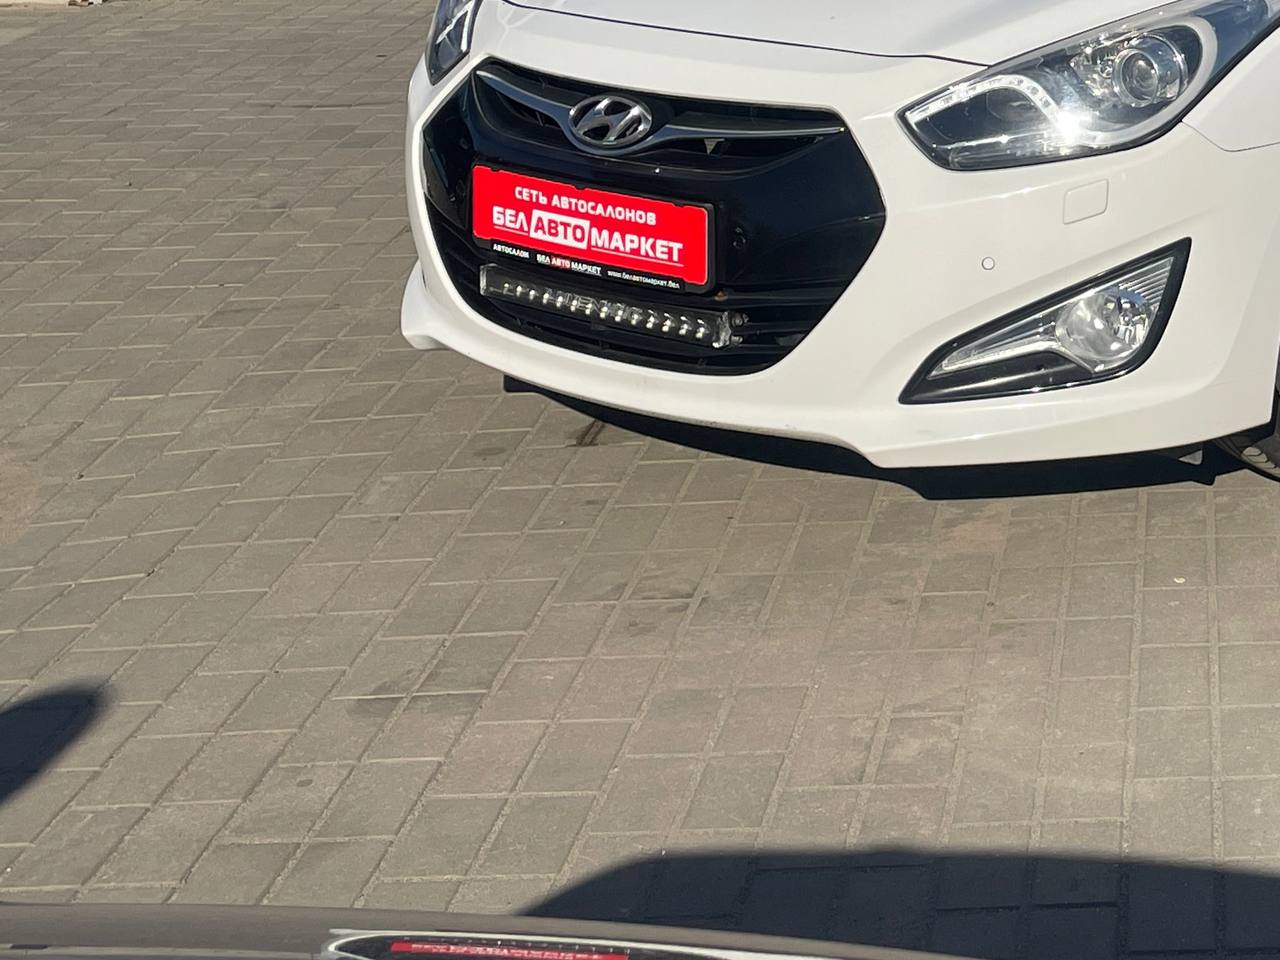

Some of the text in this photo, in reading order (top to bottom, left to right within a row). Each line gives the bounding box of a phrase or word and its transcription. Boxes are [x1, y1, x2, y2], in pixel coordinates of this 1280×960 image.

[514, 186, 657, 226] СЕТЬ АВТОСАЛОНОВ
[492, 206, 684, 262] БЕЛ АВТО МАРКЕТ
[551, 257, 571, 269] АВТО
[571, 262, 602, 275] МАРКЕТ
